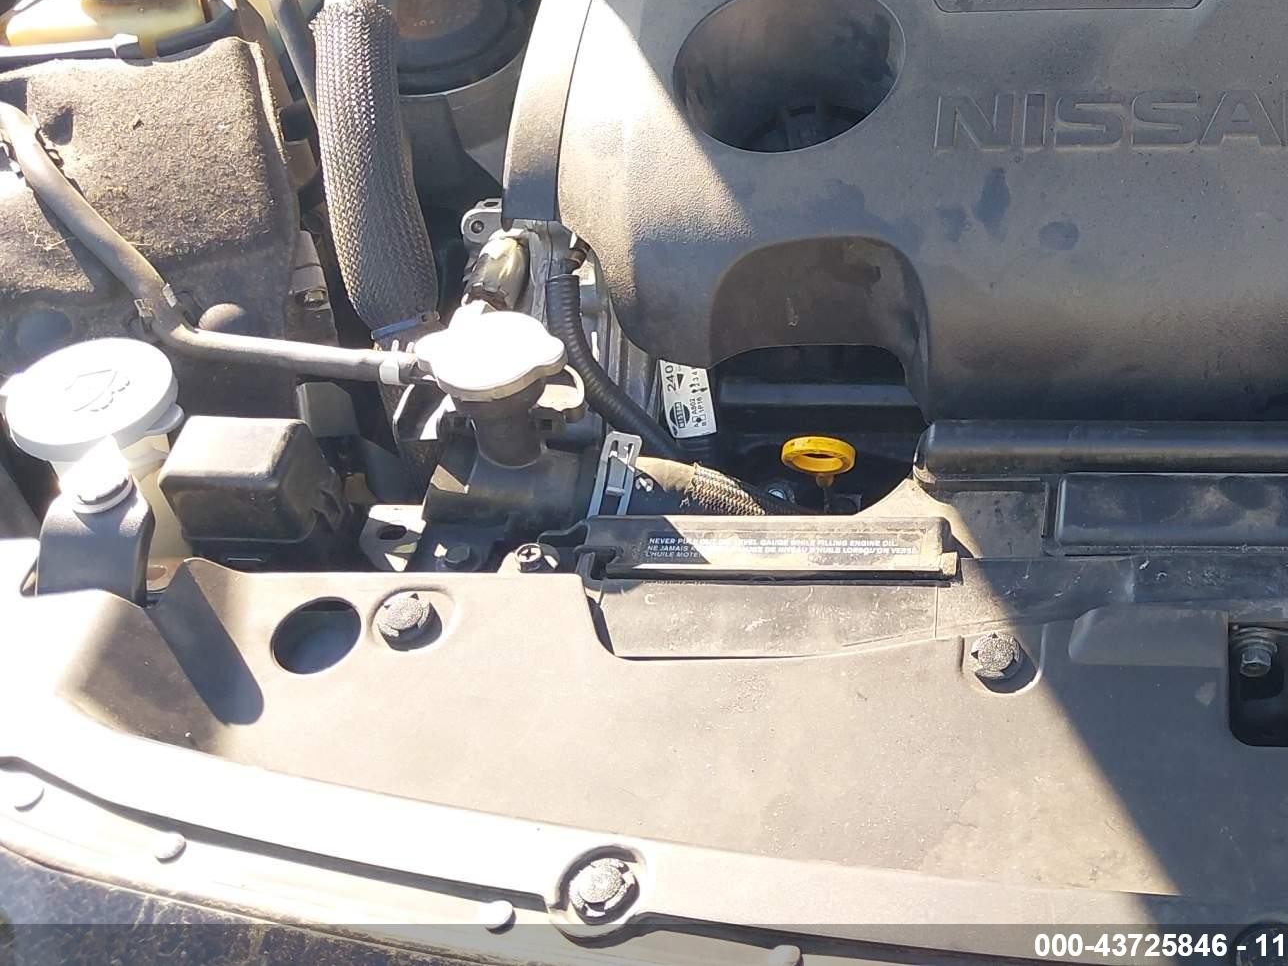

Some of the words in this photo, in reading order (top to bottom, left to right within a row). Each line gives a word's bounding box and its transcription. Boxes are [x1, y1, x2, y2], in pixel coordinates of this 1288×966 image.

[665, 361, 677, 392] 240
[649, 537, 675, 545] NEVER
[817, 538, 848, 547] FILLING
[850, 539, 880, 547] ENGINE
[660, 545, 688, 553] JAMAIS
